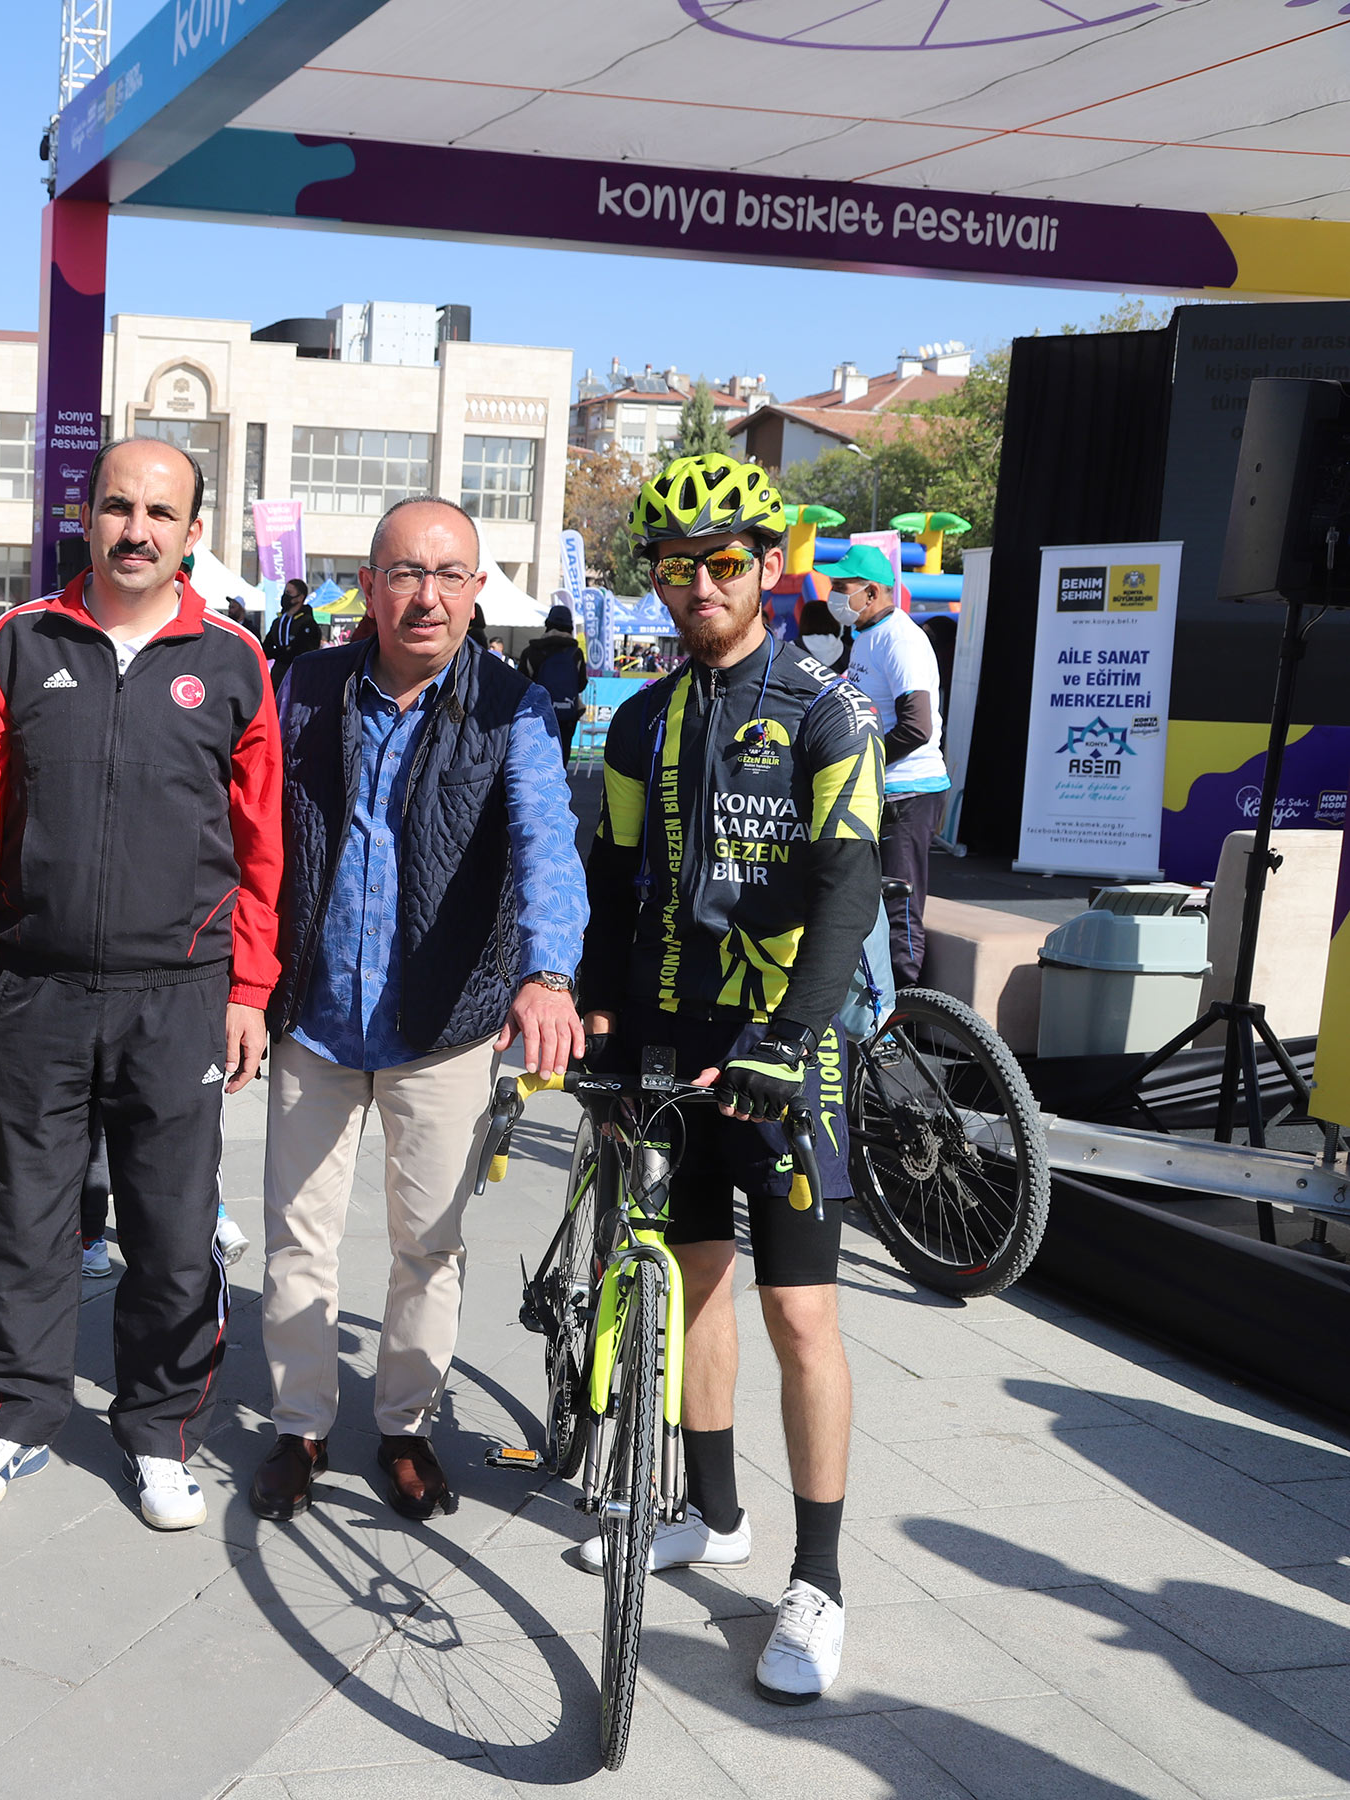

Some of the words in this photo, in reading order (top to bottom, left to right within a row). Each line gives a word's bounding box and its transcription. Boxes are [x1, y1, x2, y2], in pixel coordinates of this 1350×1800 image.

[173, 0, 247, 66] kony
[597, 176, 726, 235] konya
[736, 187, 884, 237] bisiklet
[892, 202, 1059, 252] festivali
[57, 410, 93, 424] konya
[54, 424, 96, 436] bisiklet
[50, 438, 99, 450] festivali
[1061, 577, 1103, 590] BENİM
[1060, 589, 1102, 603] ŞEHRİM
[1072, 617, 1138, 626] www.konya.bel.tr
[1057, 647, 1092, 664] AİLE
[1097, 650, 1150, 664] SANAT
[43, 679, 78, 689] adidas
[1063, 674, 1081, 686] ve
[1086, 668, 1141, 686] EĞİTİM
[1050, 691, 1151, 708] MERKEZLERİ
[1068, 759, 1121, 775] ASEM
[659, 769, 680, 813] BİLİR
[1321, 794, 1347, 802] KONY
[714, 791, 798, 818] KONYA
[1243, 798, 1300, 827] Koya
[664, 818, 683, 872] GEZEN
[715, 838, 789, 863] GEZEN
[713, 858, 768, 885] BİLİR
